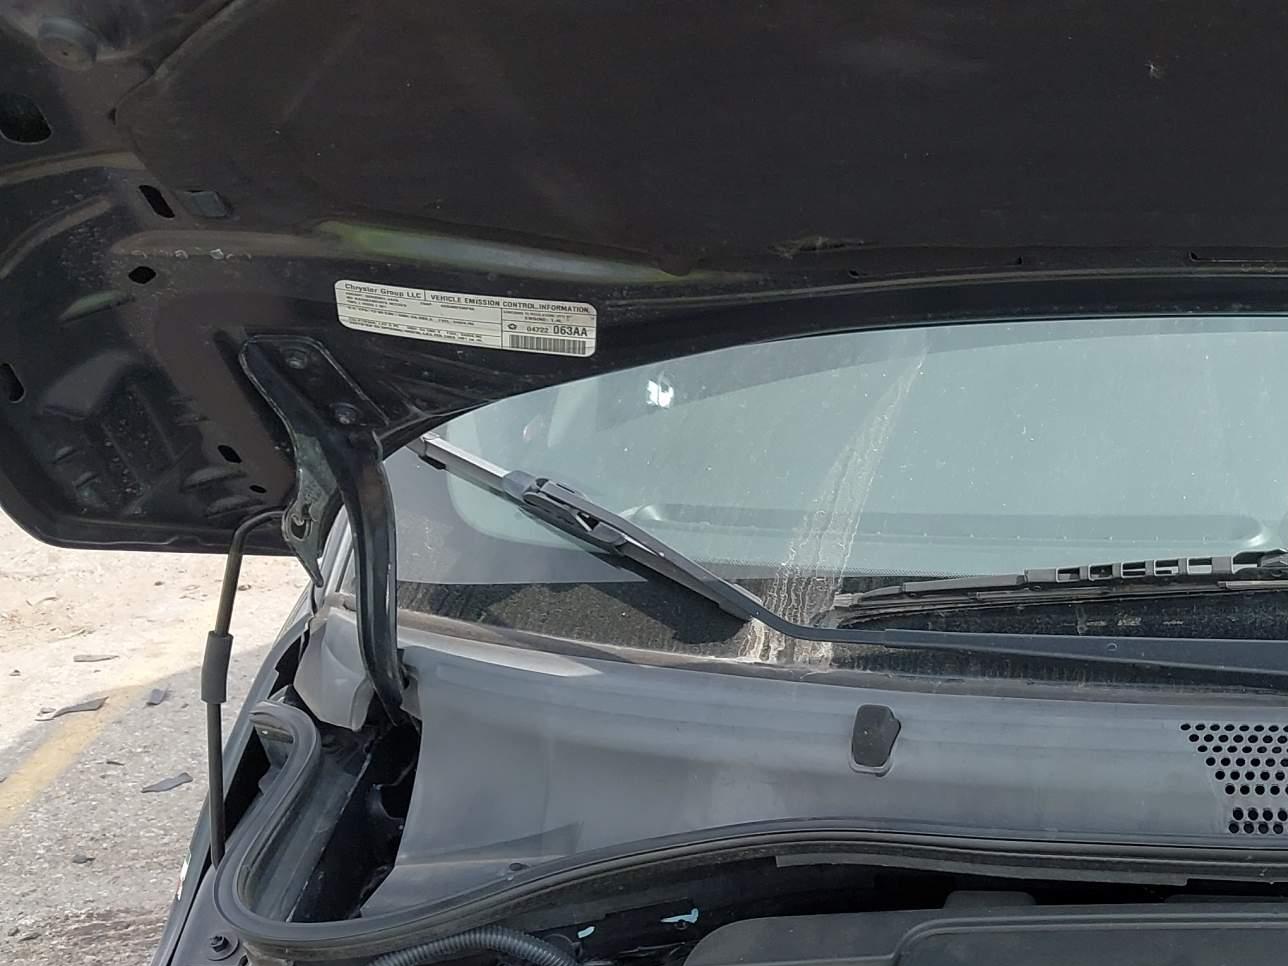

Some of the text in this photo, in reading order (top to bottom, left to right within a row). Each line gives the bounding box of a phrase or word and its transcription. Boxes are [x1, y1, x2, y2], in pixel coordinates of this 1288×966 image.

[344, 283, 378, 294] Chrysler
[380, 288, 404, 298] Group
[430, 294, 461, 303] VEHICLE
[464, 298, 500, 307] EMISSION
[503, 301, 535, 309] CONTROL
[538, 303, 589, 313] INFORMATION
[526, 325, 588, 337] 04722 063AA
